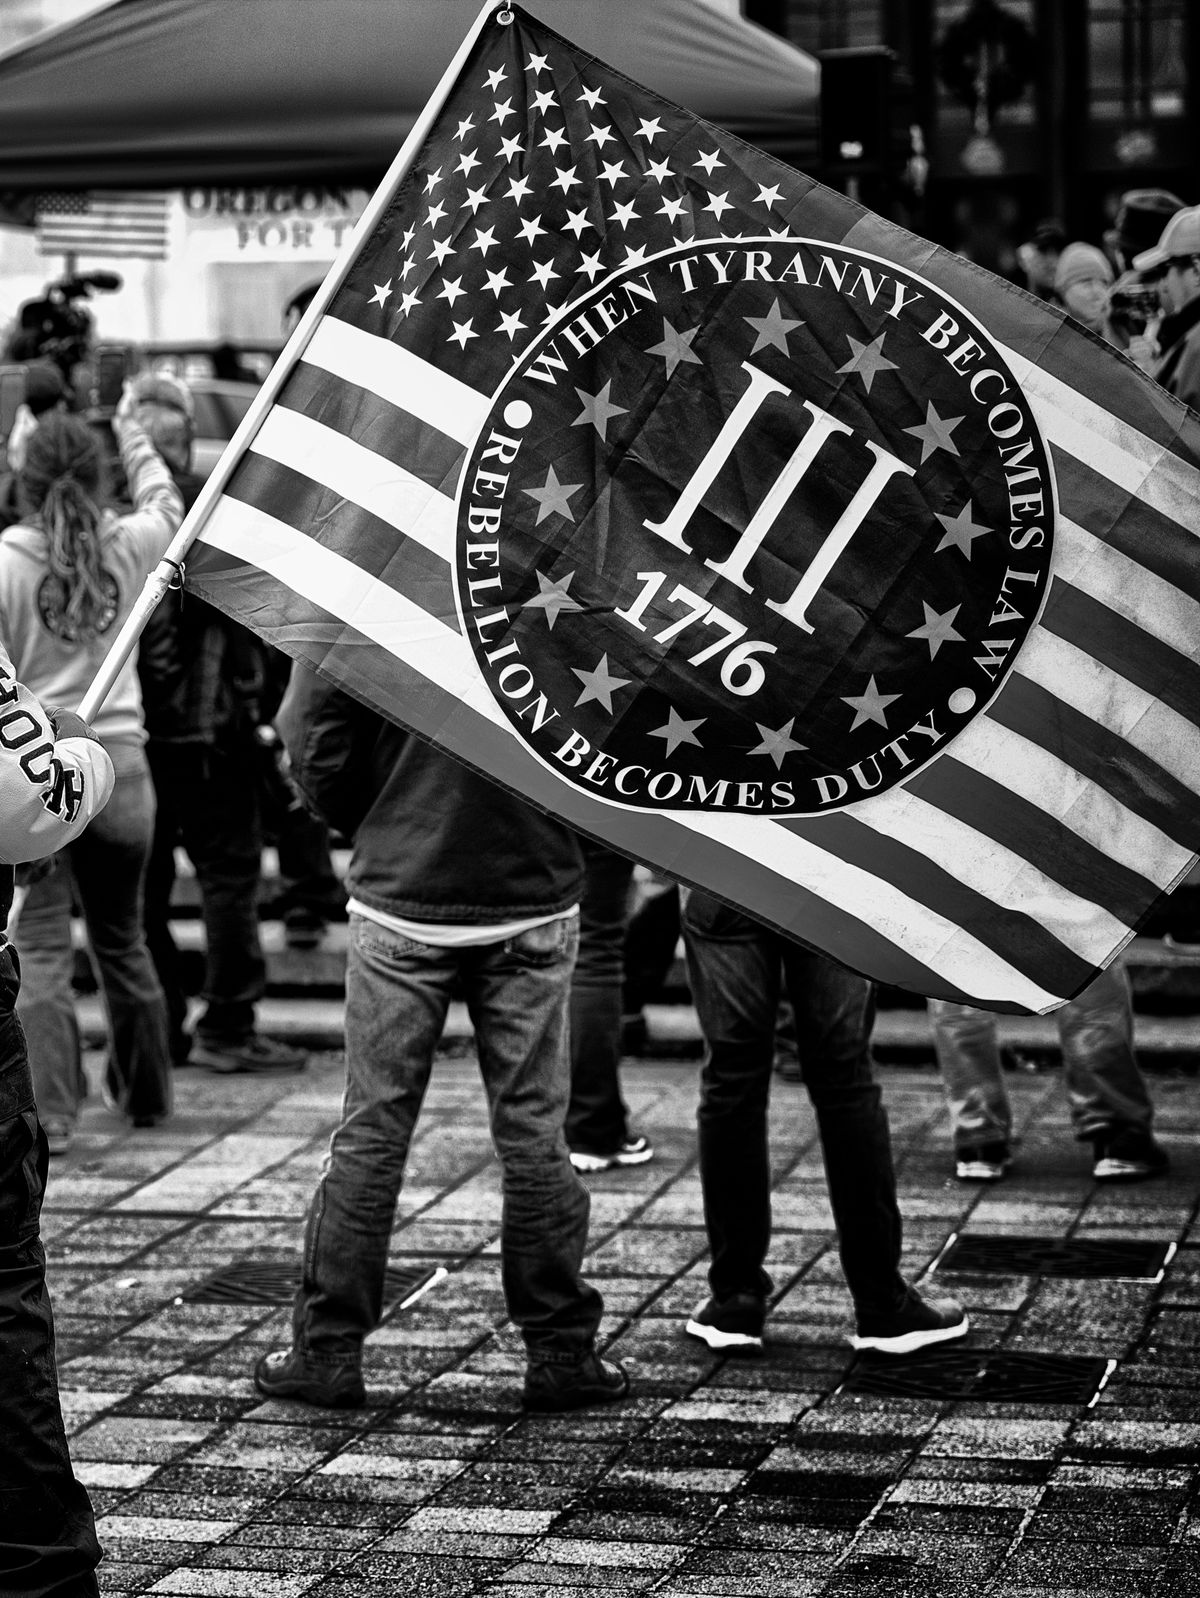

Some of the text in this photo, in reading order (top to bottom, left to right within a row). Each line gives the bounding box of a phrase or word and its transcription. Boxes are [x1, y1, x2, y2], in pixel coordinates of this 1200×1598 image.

[465, 427, 946, 809] REBELLION BECOMES DUTY
[522, 249, 1046, 682] WHEN TYRANNY BECOMES LAW
[642, 360, 917, 635] III
[613, 570, 778, 697] 1776
